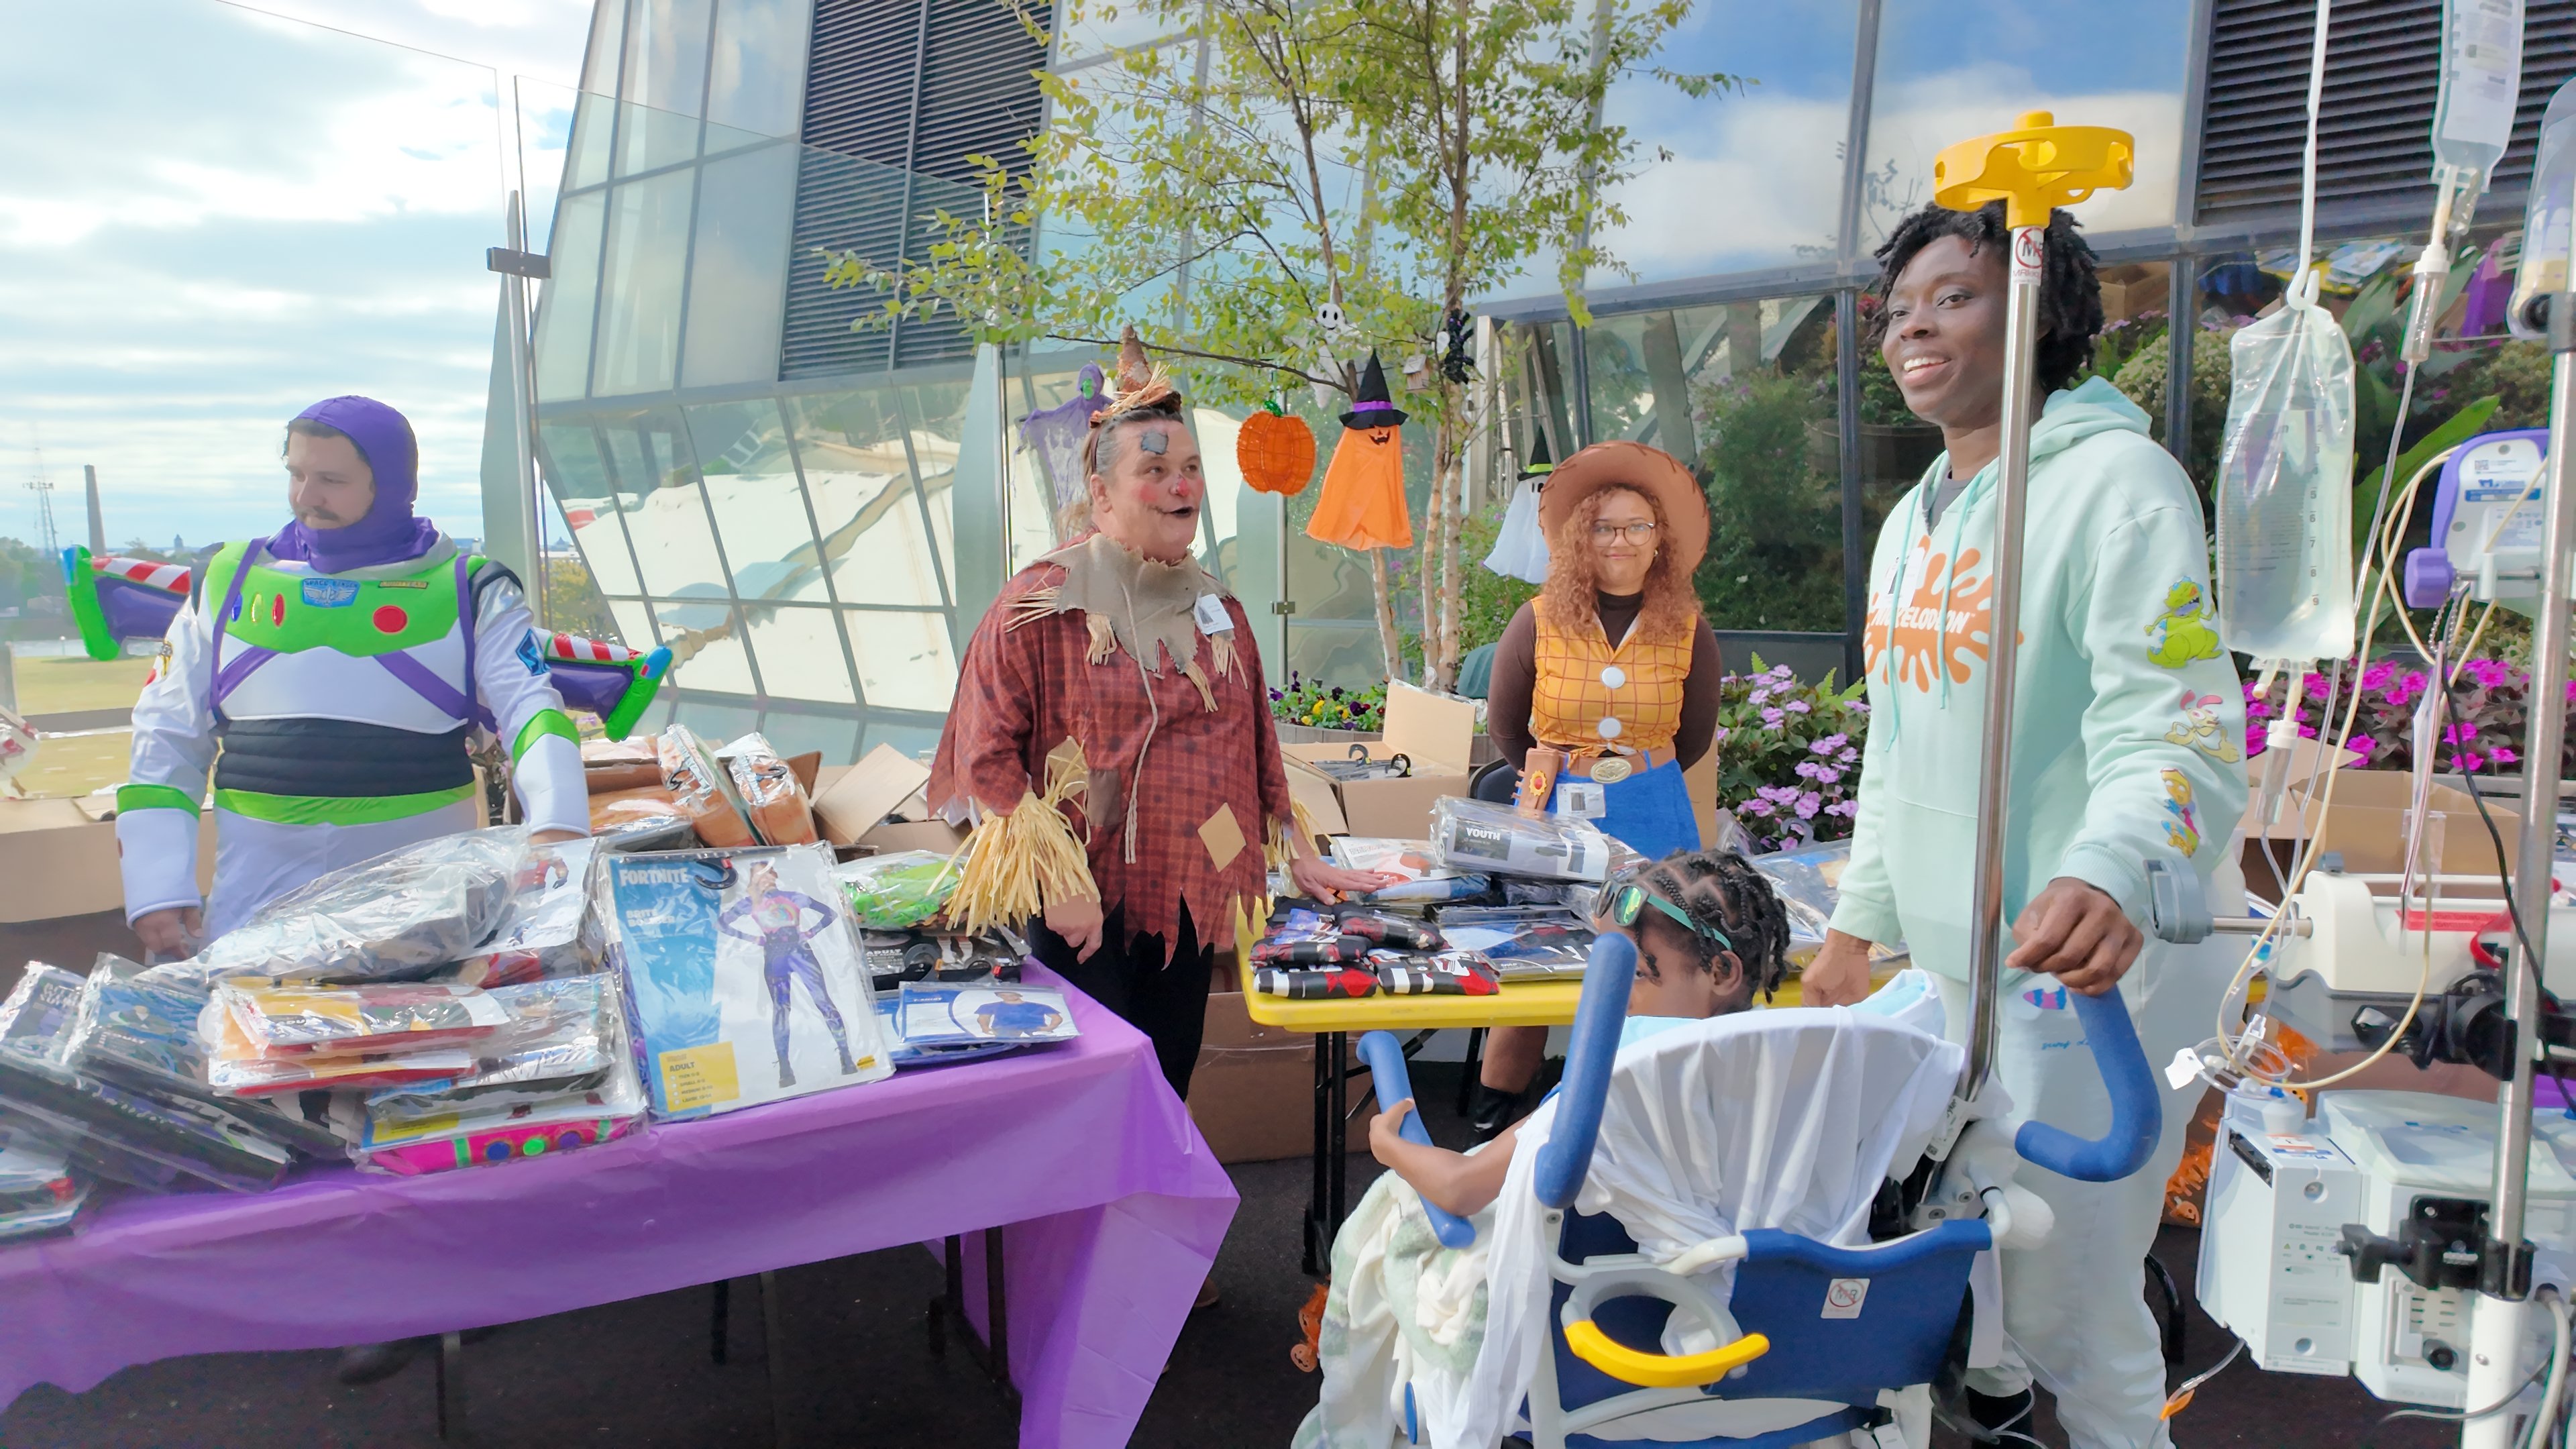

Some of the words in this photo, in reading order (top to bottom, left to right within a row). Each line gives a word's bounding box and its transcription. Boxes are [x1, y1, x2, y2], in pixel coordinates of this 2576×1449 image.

[2310, 490, 2317, 500] 5
[2309, 514, 2316, 523] 6
[2310, 539, 2316, 548] 7
[2310, 569, 2317, 578] 8
[2312, 597, 2320, 606] 9
[1466, 827, 1501, 841] YOUTH
[619, 867, 690, 887] FORTNITE
[626, 908, 657, 919] BRITE
[628, 916, 676, 927] BOER
[866, 949, 902, 957] ADULT
[669, 1062, 696, 1072] ADULT
